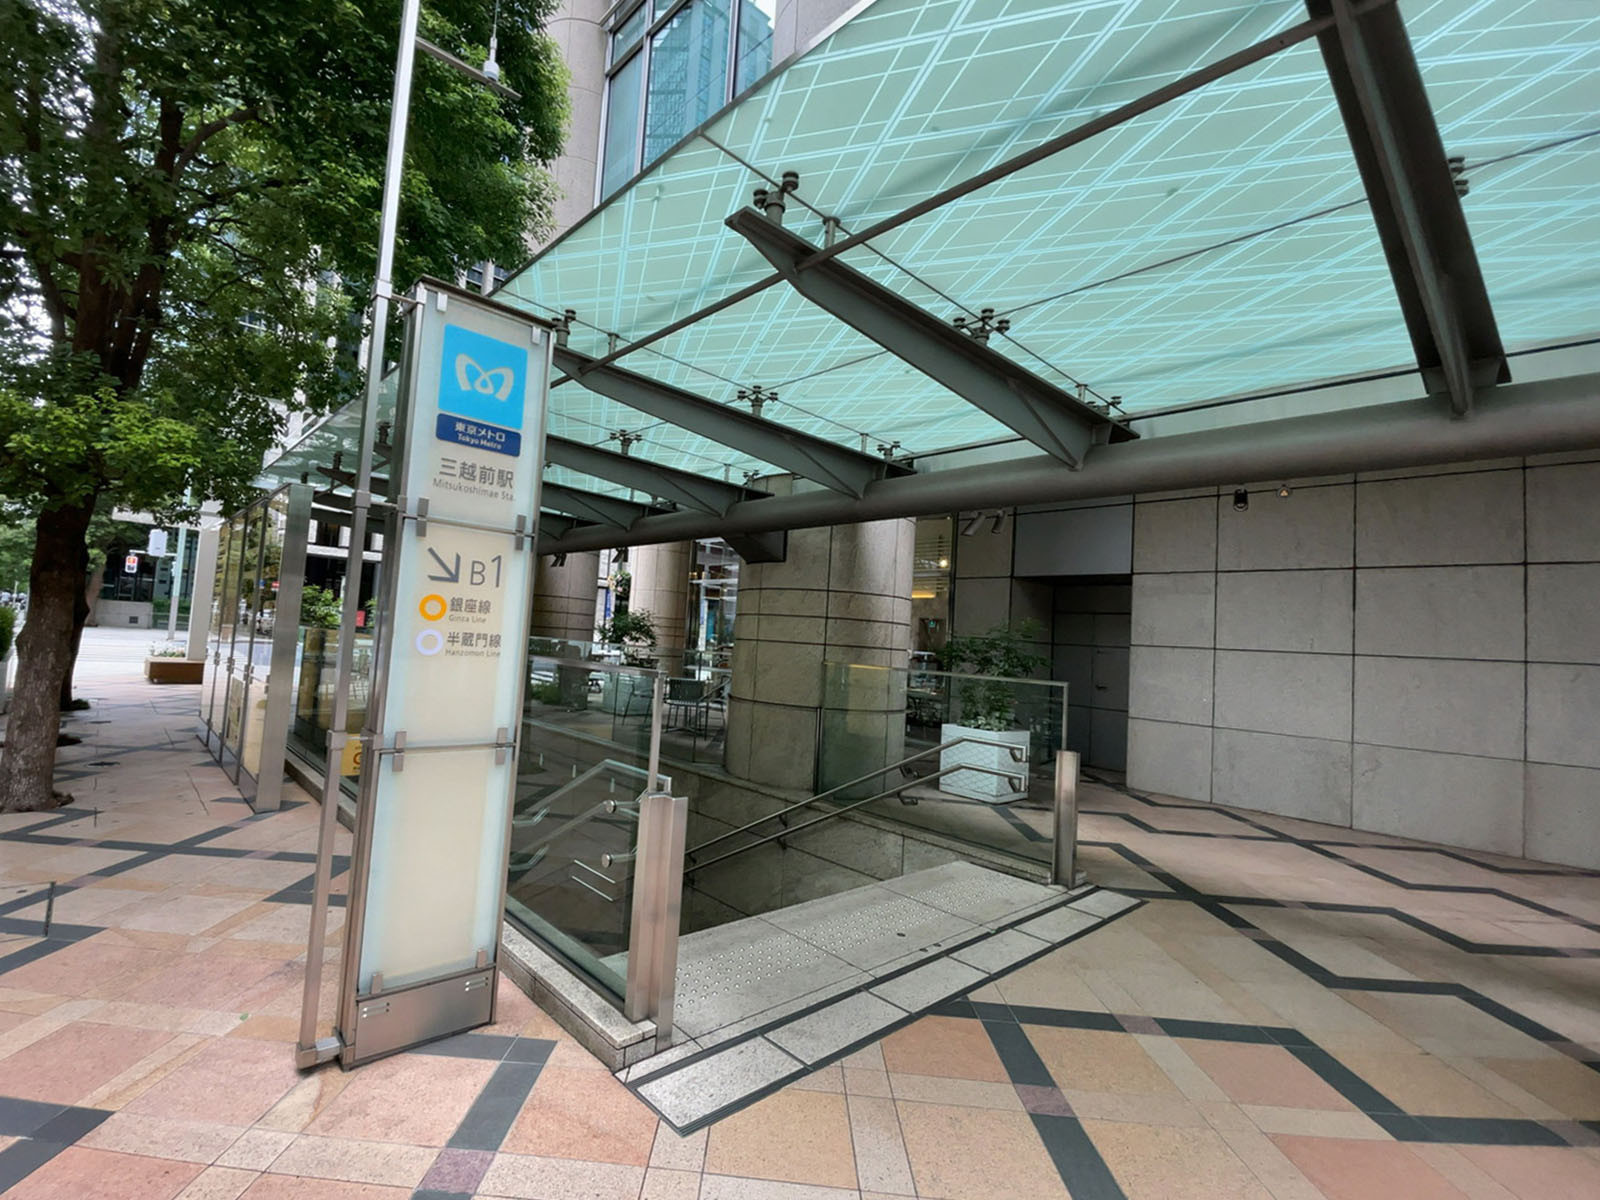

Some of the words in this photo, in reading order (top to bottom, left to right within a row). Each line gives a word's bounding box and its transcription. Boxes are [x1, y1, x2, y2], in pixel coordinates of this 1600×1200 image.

[455, 422, 505, 442] 東京メトロ
[457, 433, 479, 445] Tokyo
[480, 438, 502, 450] Metro
[439, 457, 514, 489] 三越前駅
[432, 478, 499, 499] Mitsukoshimae
[469, 554, 503, 588] B1
[449, 597, 491, 614] 銀座線
[448, 614, 470, 623] Ginza
[471, 615, 487, 624] Line
[447, 631, 501, 648] 半蔵門線
[445, 649, 485, 657] Hanzomon
[486, 649, 501, 657] Line
